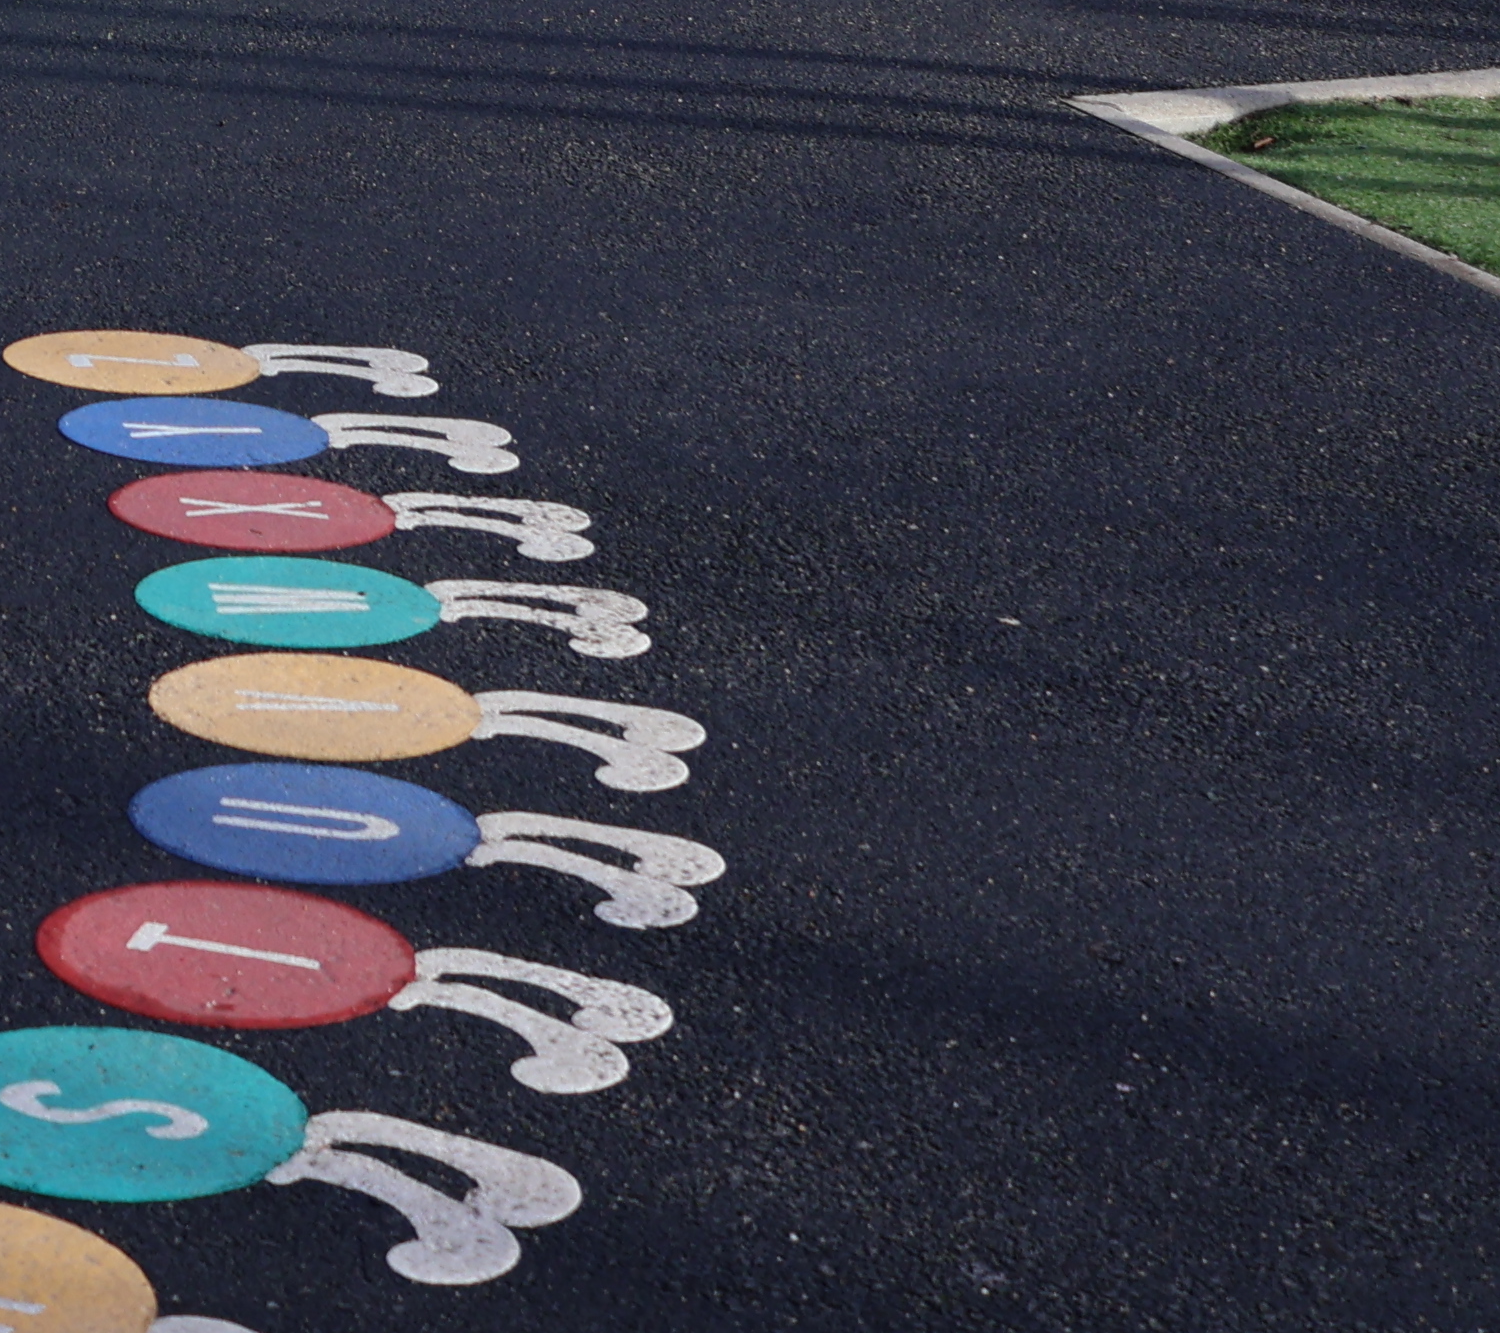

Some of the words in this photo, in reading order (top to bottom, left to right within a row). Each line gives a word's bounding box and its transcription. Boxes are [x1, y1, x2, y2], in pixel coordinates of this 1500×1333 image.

[65, 353, 200, 368] Z
[122, 422, 263, 439] Y
[179, 496, 330, 521] X
[207, 582, 371, 615] W
[234, 689, 400, 712] V
[212, 796, 400, 841] U
[126, 921, 321, 971] T
